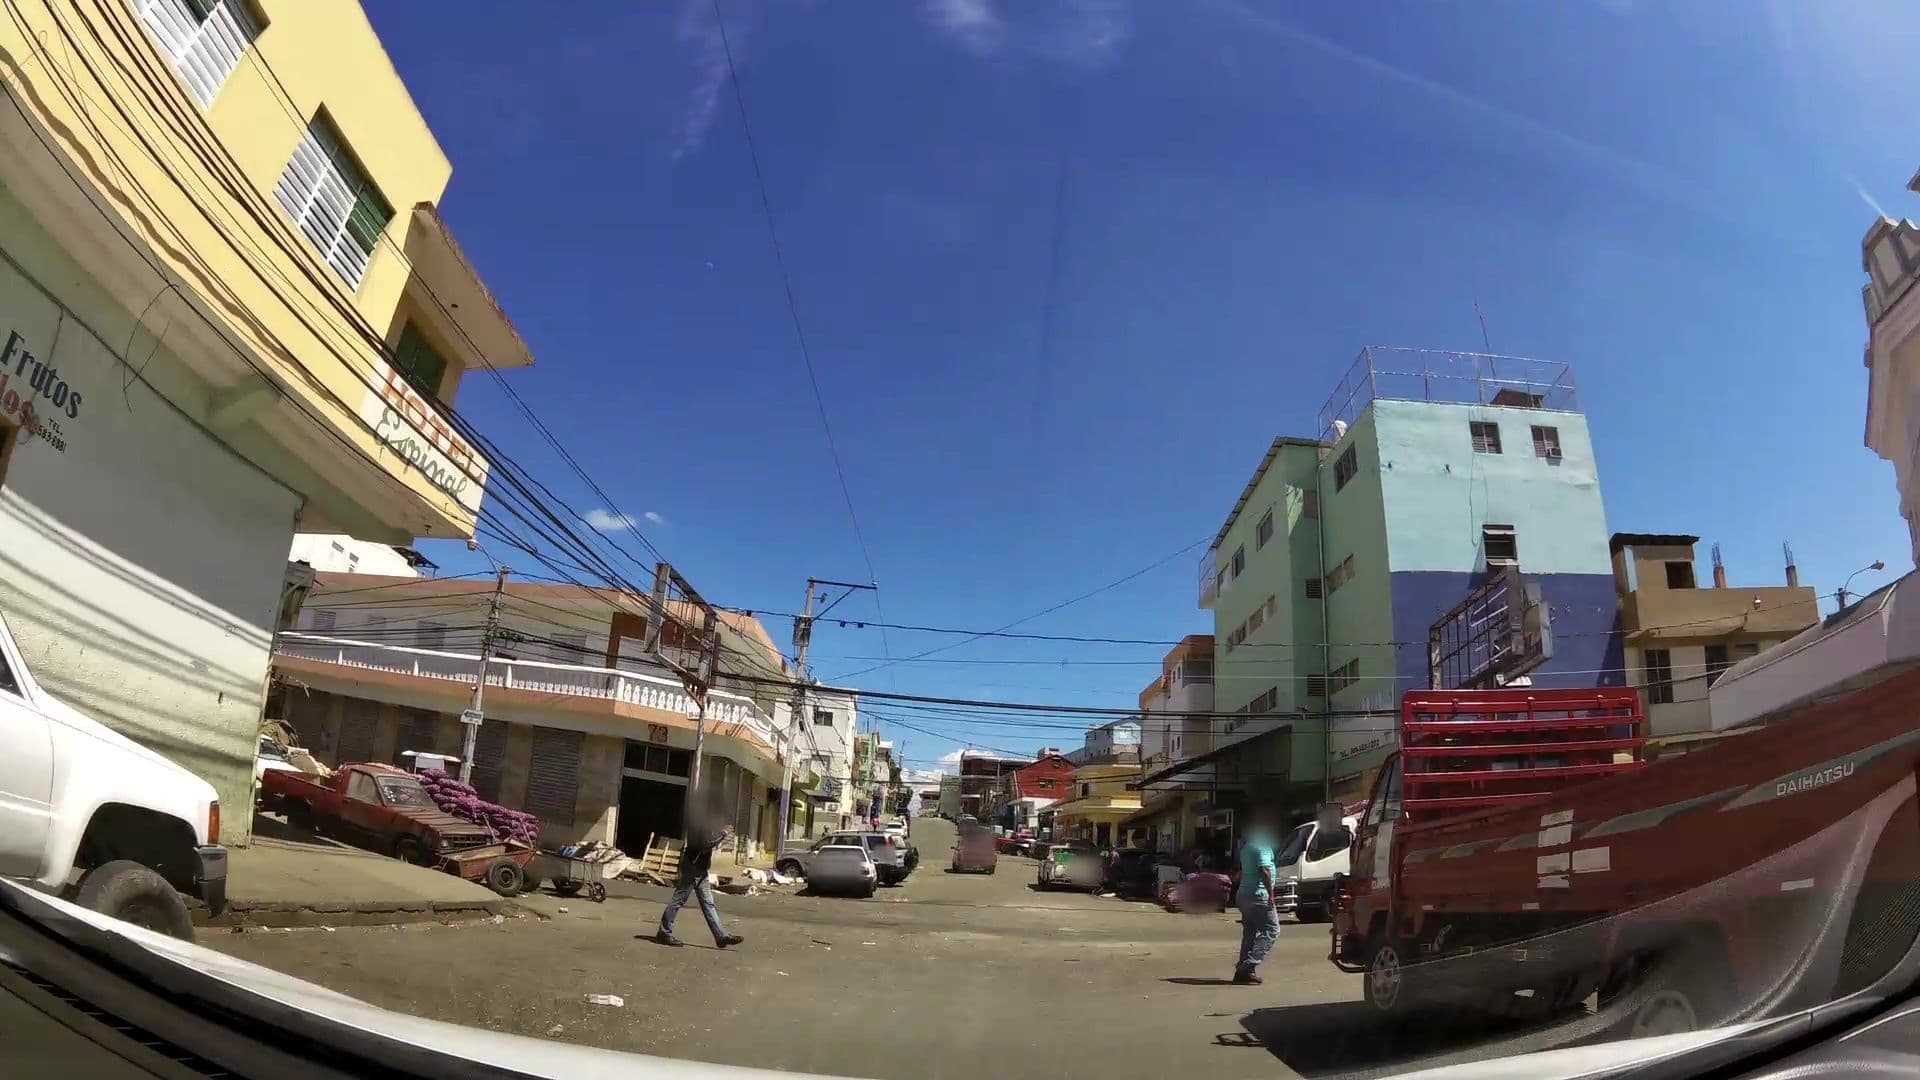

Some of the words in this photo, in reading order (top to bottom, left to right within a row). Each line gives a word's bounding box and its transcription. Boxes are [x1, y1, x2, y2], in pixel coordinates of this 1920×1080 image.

[0, 329, 82, 419] Frutos
[382, 367, 483, 482] HOTEL
[1776, 761, 1854, 796] DAIHATSU
